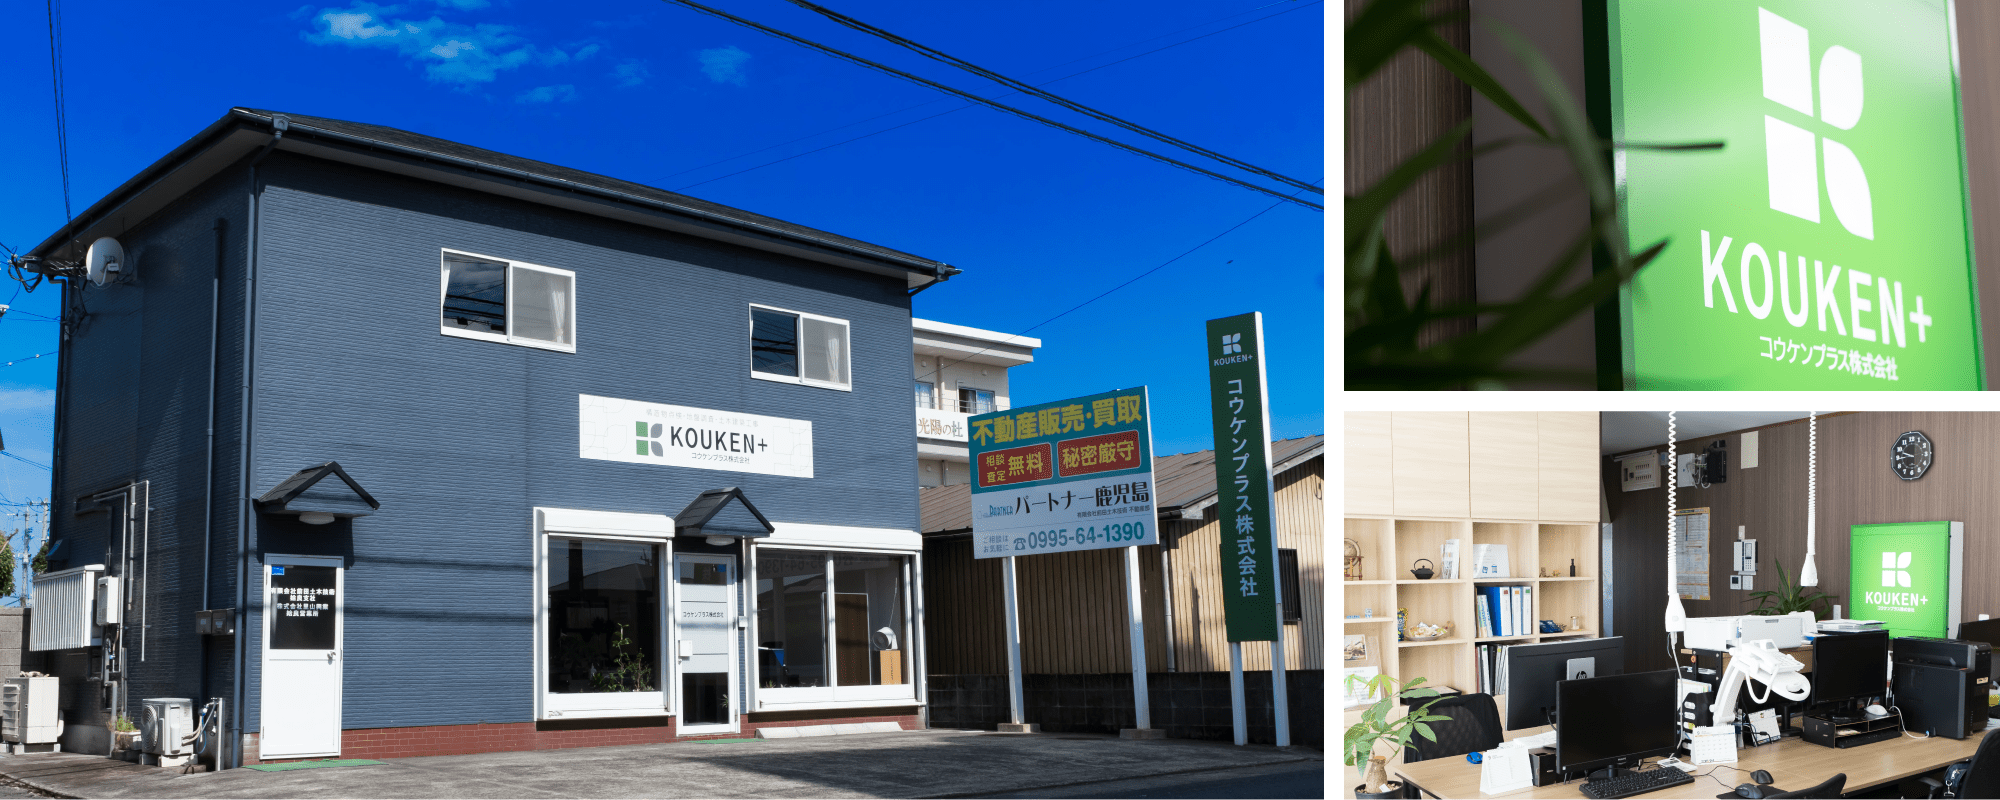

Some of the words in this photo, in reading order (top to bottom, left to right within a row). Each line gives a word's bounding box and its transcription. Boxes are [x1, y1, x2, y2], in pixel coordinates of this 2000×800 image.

[1701, 229, 1933, 348] KOUKEN+
[1213, 353, 1253, 366] KOUKEN+
[1759, 336, 1899, 381] コウケンプラス株式会社
[917, 418, 963, 438] 光陽の杜
[972, 395, 1142, 447] 不動産販売・買取
[670, 425, 768, 454] KOUKEN+
[691, 452, 750, 464] コウケンプラス株式会社
[1008, 451, 1044, 476] 無料
[1062, 440, 1135, 469] 秘密厳守
[1015, 481, 1150, 515] パートナー鹿児島
[1227, 377, 1259, 598] コウケンプラス株式会社
[1028, 521, 1145, 550] 0995-64-1390
[1865, 591, 1928, 606] KOUKEN+
